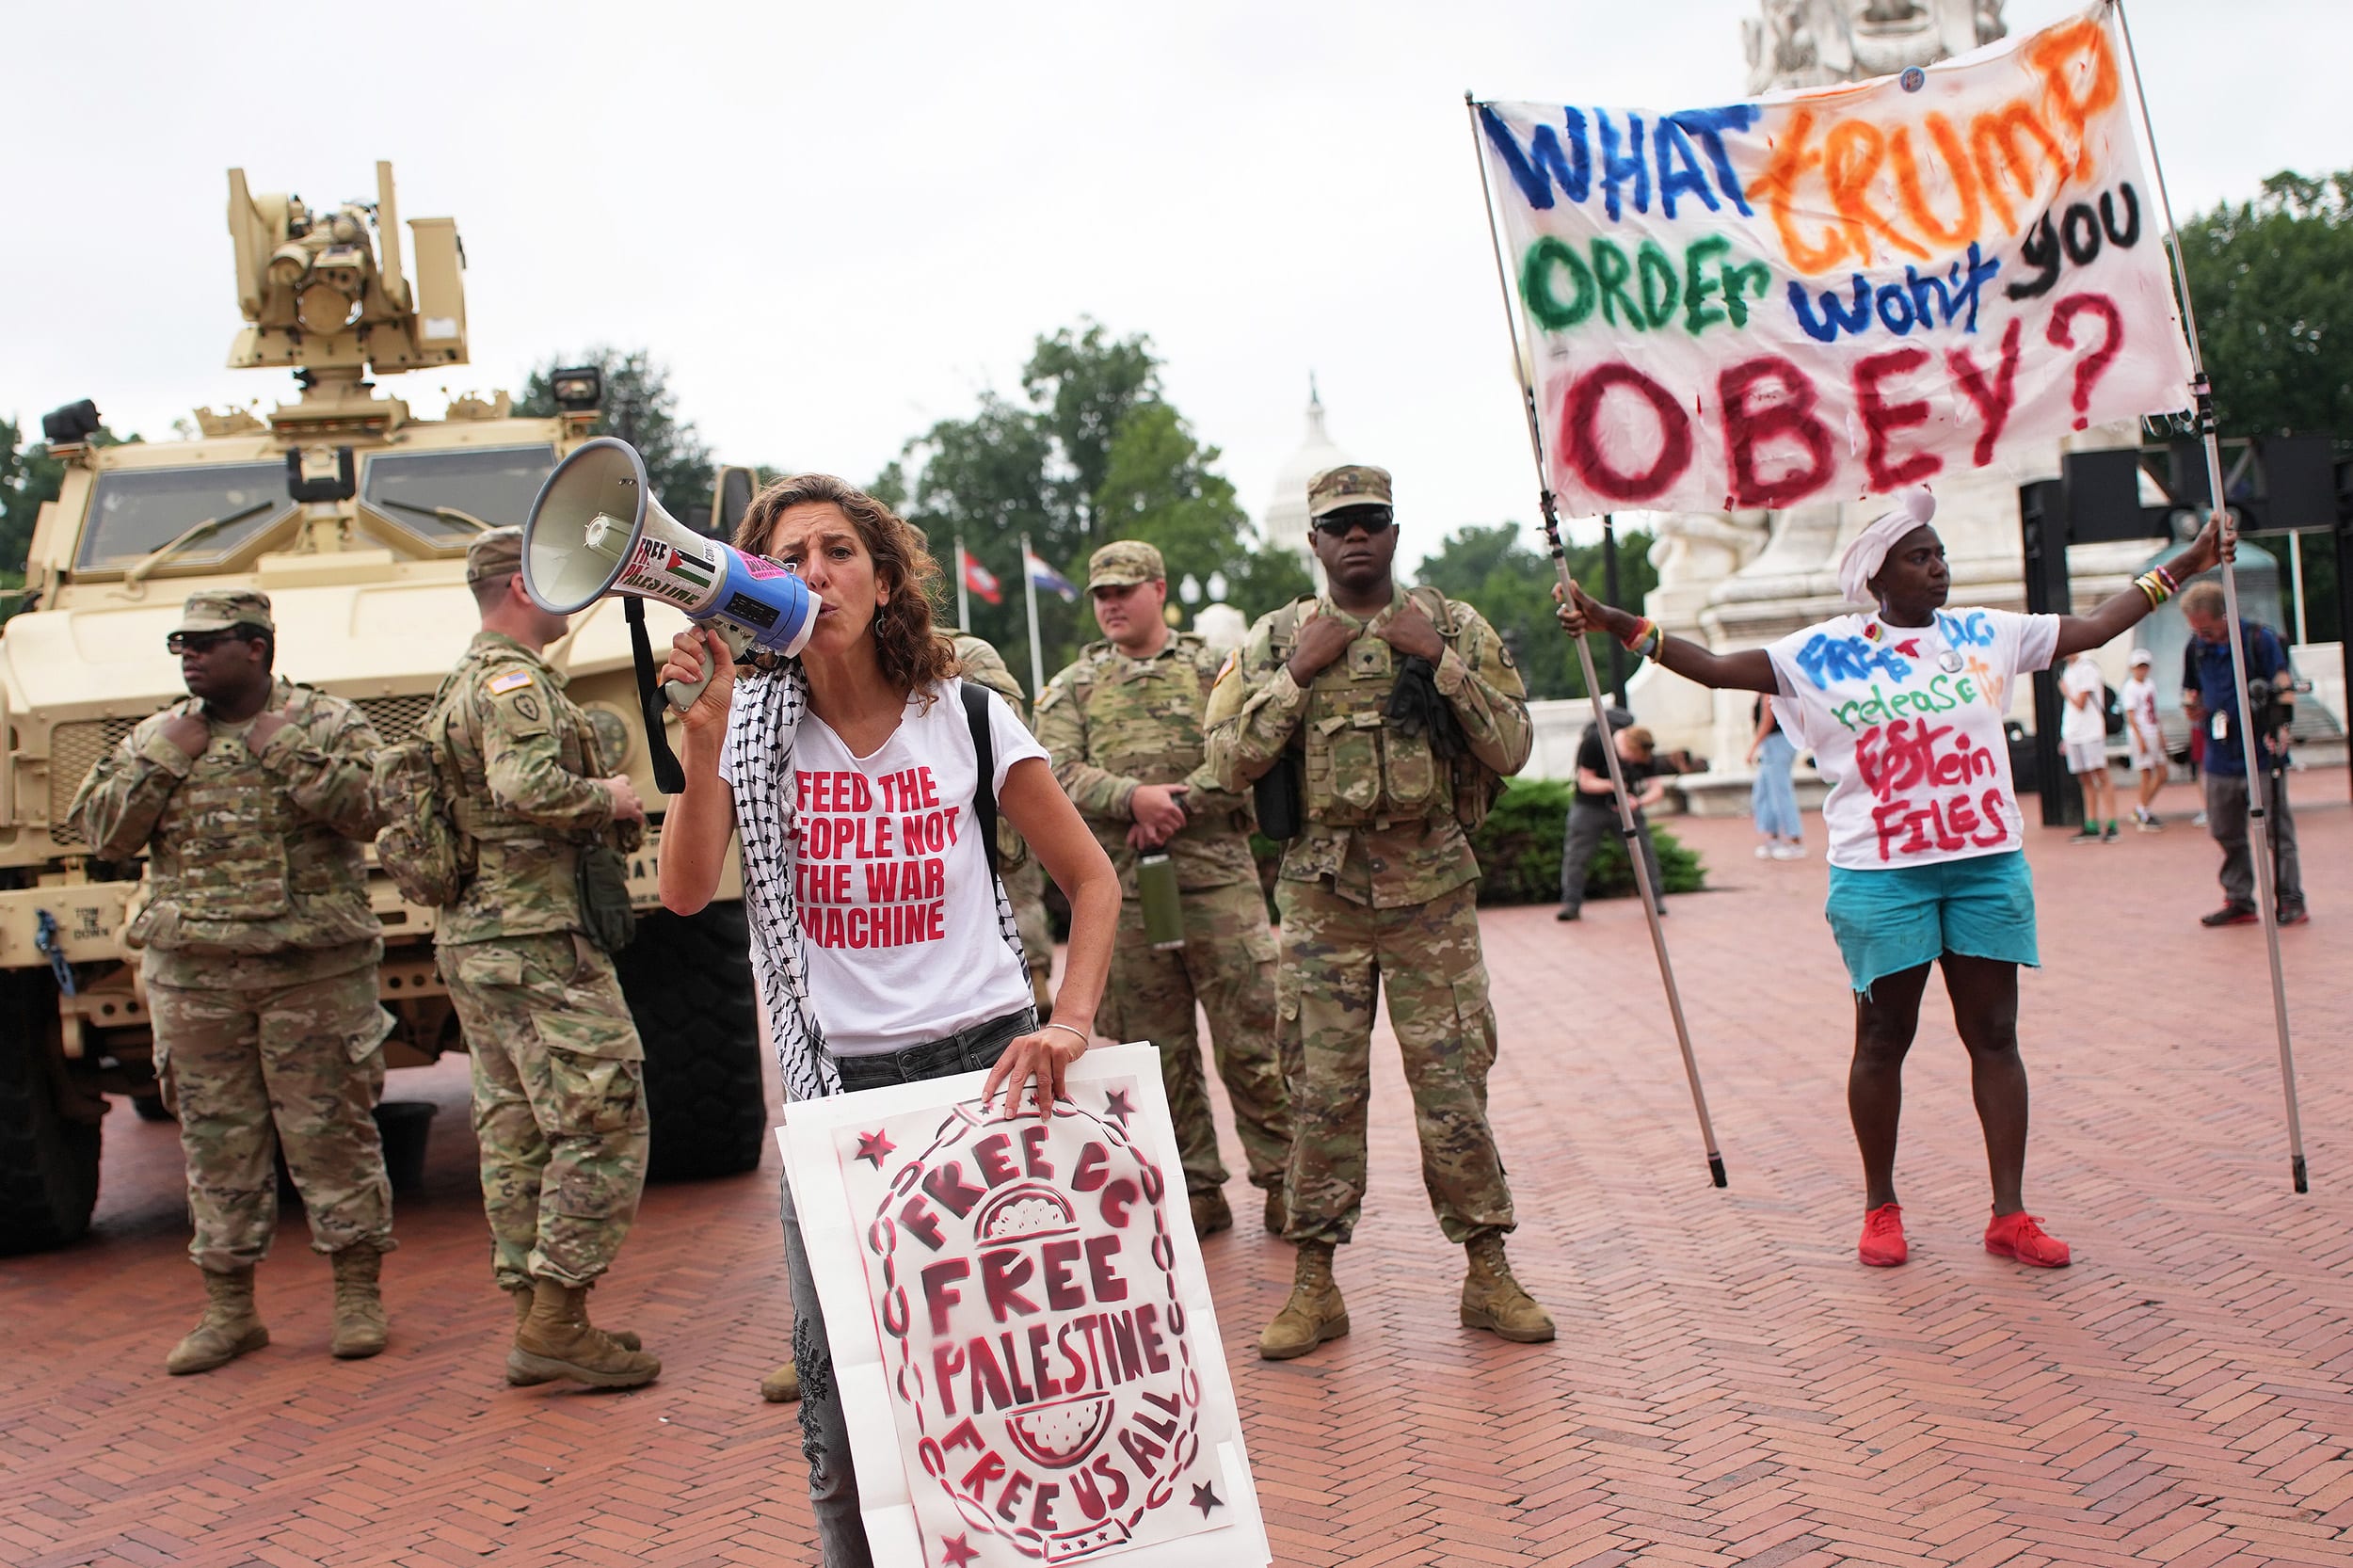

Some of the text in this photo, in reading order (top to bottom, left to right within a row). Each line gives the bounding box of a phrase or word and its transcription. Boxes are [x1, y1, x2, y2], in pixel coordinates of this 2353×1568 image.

[1480, 103, 1761, 222] WHAT
[632, 537, 668, 567] FREE
[621, 563, 707, 606] PALESTINE
[795, 766, 940, 813] FEED THE
[902, 806, 960, 856] NOT
[1871, 788, 2008, 862] FILES
[794, 857, 945, 904] THE WAR
[797, 899, 945, 950] MACHINE
[898, 1125, 1056, 1253] FREE
[920, 1234, 1129, 1336] FREE
[932, 1303, 1172, 1417] PALESTINE
[941, 1391, 1183, 1531] FREE US ALL
